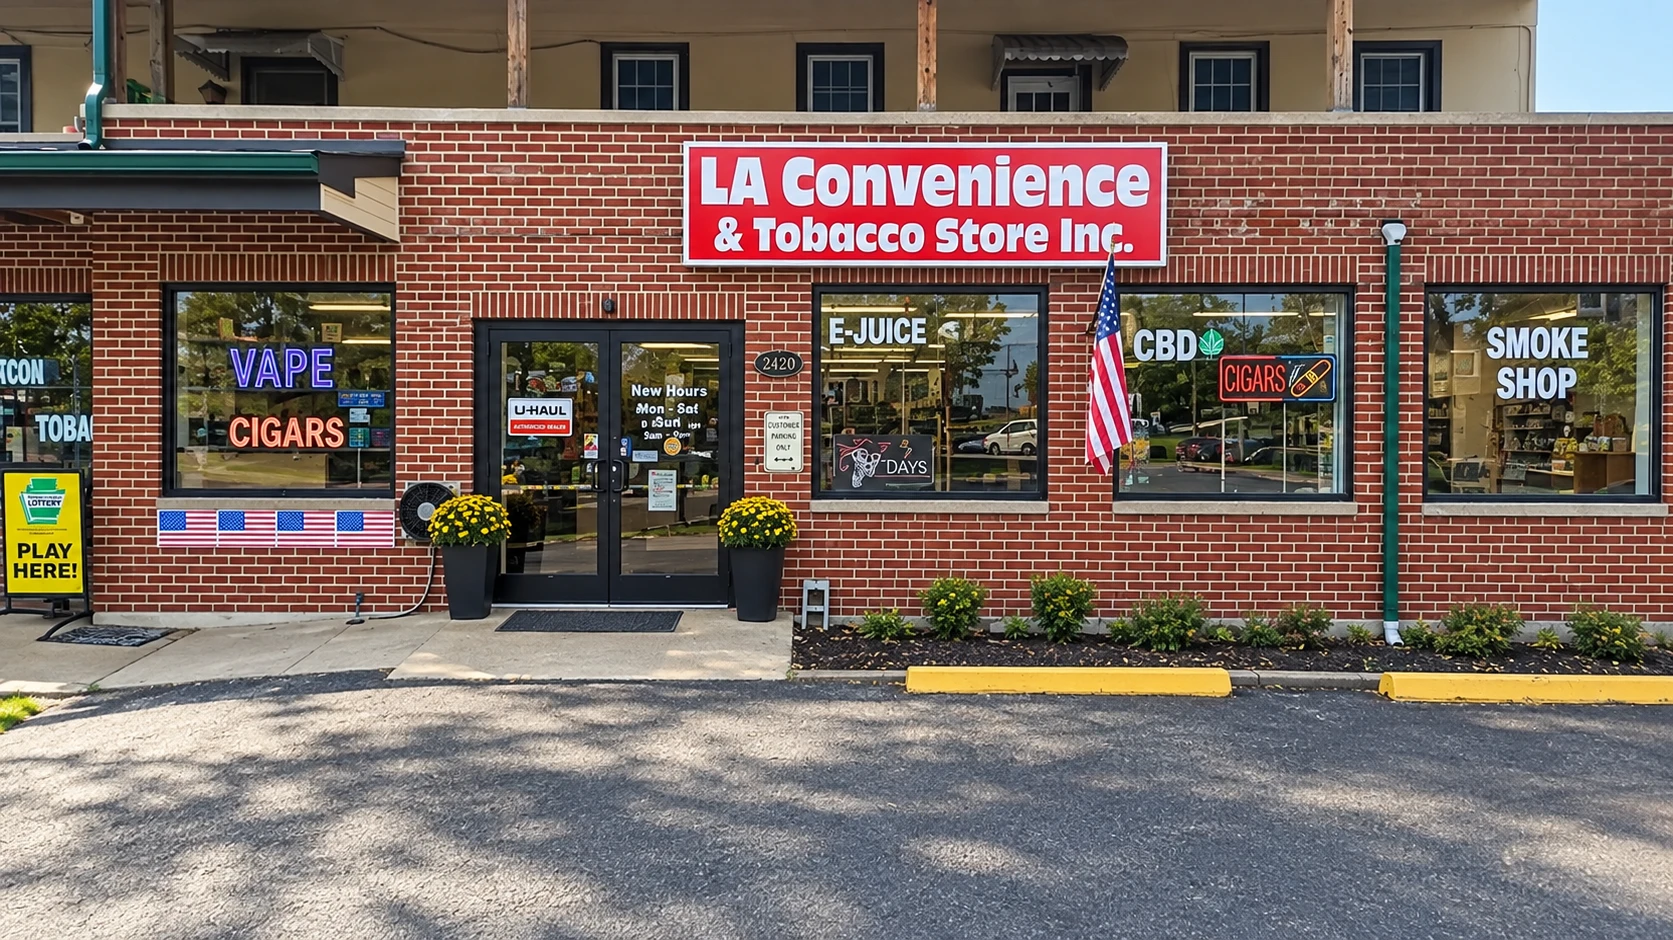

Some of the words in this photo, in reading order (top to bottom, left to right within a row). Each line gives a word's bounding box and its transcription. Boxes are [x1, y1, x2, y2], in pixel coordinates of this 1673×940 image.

[700, 156, 769, 206] LA
[782, 155, 1151, 207] Convenience
[714, 216, 744, 252] &
[753, 216, 925, 252] Tobacco
[935, 217, 1050, 252] Store
[1060, 217, 1134, 253] Inc.
[829, 317, 927, 345] E-JUICE
[1133, 329, 1197, 361] CBD
[1486, 326, 1589, 359] SMOKE
[230, 348, 334, 388] VAPE
[762, 356, 796, 371] 2420
[631, 384, 662, 397] New
[666, 384, 708, 397] Hours
[1224, 364, 1286, 393] CIGARS
[1496, 366, 1578, 400] SHOP
[514, 405, 567, 416] U-HAUL
[35, 414, 93, 442] TOBA
[229, 416, 345, 448] CIGARS
[886, 460, 928, 475] DAYS
[17, 542, 73, 559] PLAY
[13, 563, 77, 579] HERE!
